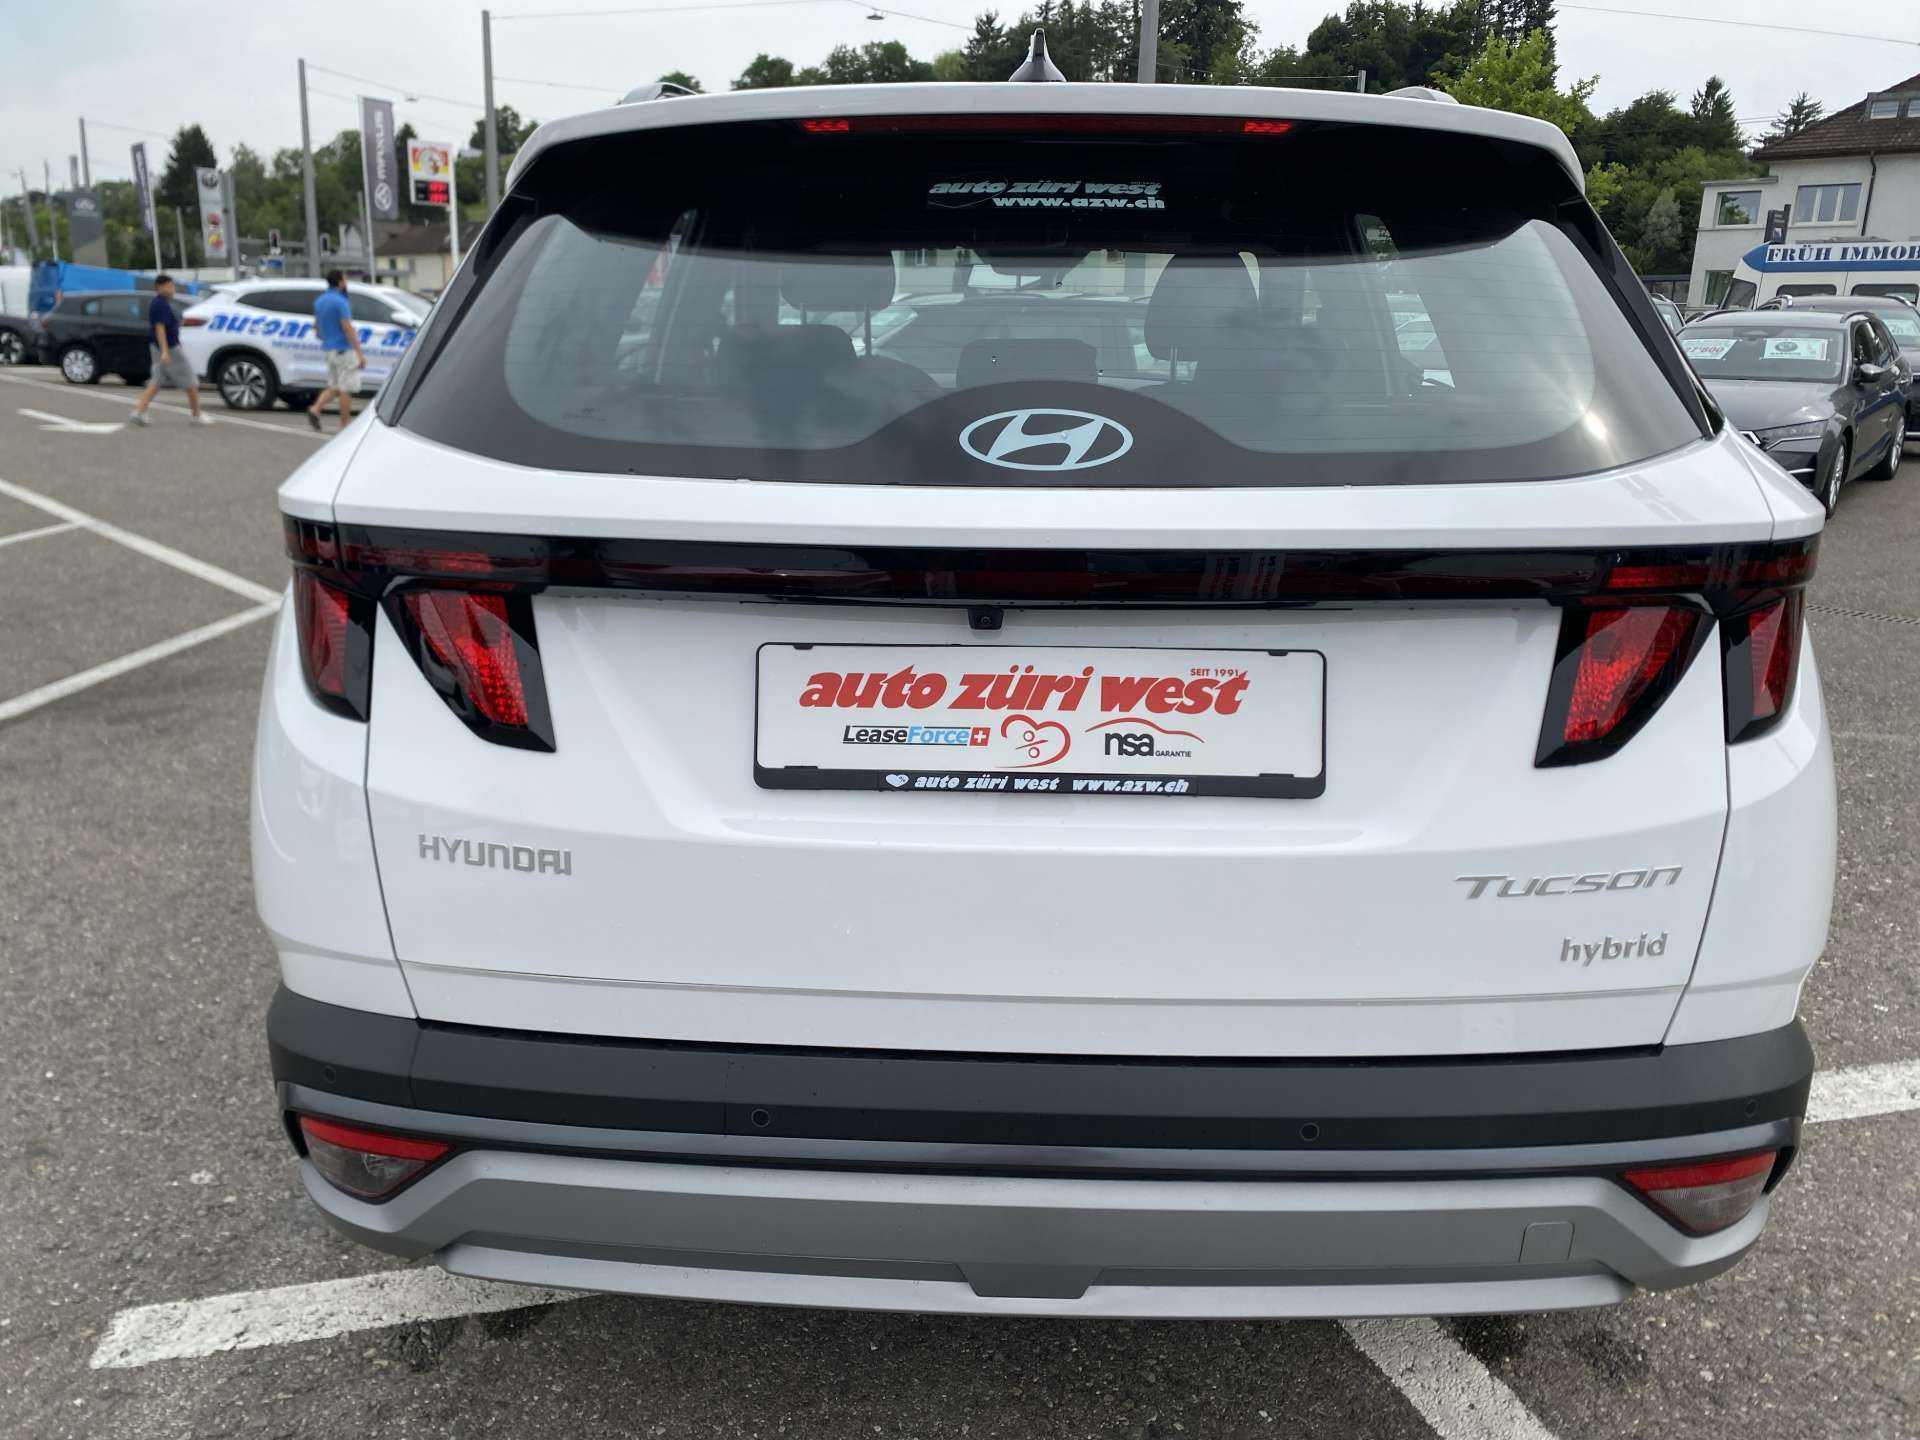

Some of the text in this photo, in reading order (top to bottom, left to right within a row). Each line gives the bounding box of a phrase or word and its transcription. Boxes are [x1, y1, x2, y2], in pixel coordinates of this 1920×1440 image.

[929, 179, 1162, 195] auto züri west
[992, 197, 1165, 209] www.azw.ch
[1768, 245, 1832, 261] FRÜH
[207, 311, 373, 344] autoara
[1190, 668, 1239, 678] SEIT 1991
[799, 664, 1250, 715] auto züri west
[842, 725, 970, 744] LeaseForce
[1105, 732, 1192, 758] nsa GARANTIE
[914, 774, 1190, 793] auto züri west www.azw.ch
[418, 833, 572, 876] HYUNDAI
[1560, 931, 1668, 967] hybrid
